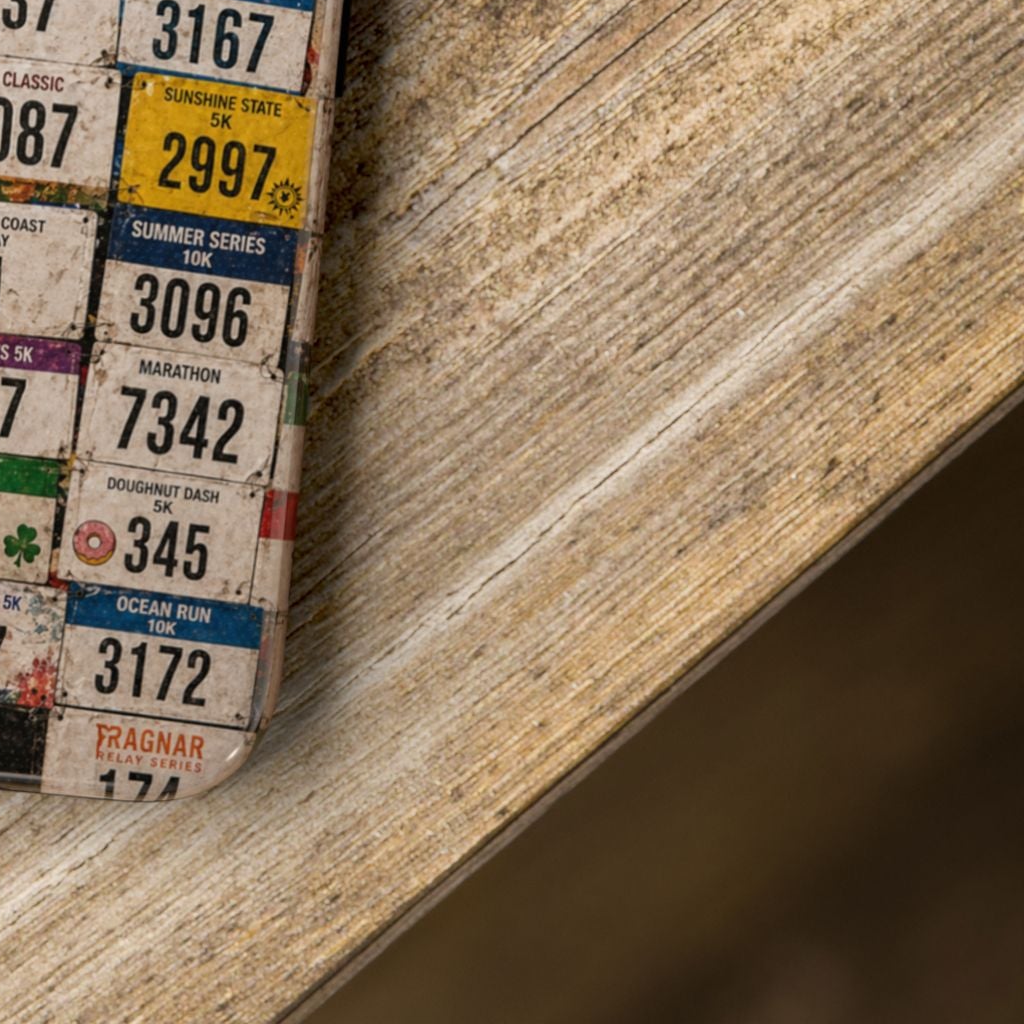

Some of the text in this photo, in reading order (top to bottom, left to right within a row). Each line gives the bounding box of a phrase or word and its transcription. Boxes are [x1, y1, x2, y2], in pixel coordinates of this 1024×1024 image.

[152, 0, 274, 73] 3167
[2, 71, 65, 93] CLASSIC
[164, 87, 282, 117] SUNSHINE STATE
[210, 114, 232, 130] 5K
[158, 131, 277, 200] 2997
[1, 216, 46, 234] COAST
[131, 220, 266, 255] SUMMER SERIES
[182, 250, 213, 268] 10K
[130, 273, 251, 347] 3096
[14, 345, 33, 363] 5K
[139, 359, 221, 384] MARATHON
[116, 385, 244, 464] 7342
[107, 477, 219, 503] DOUGHNUT DASH
[153, 500, 173, 514] 5K
[124, 516, 210, 581] 345
[3, 595, 23, 611] 5K
[116, 596, 212, 624] OCEAN RUN
[148, 620, 176, 635] 10K
[94, 637, 211, 707] 3172
[96, 723, 205, 760] RAGNAR
[96, 751, 202, 773] RELAY SERIES
